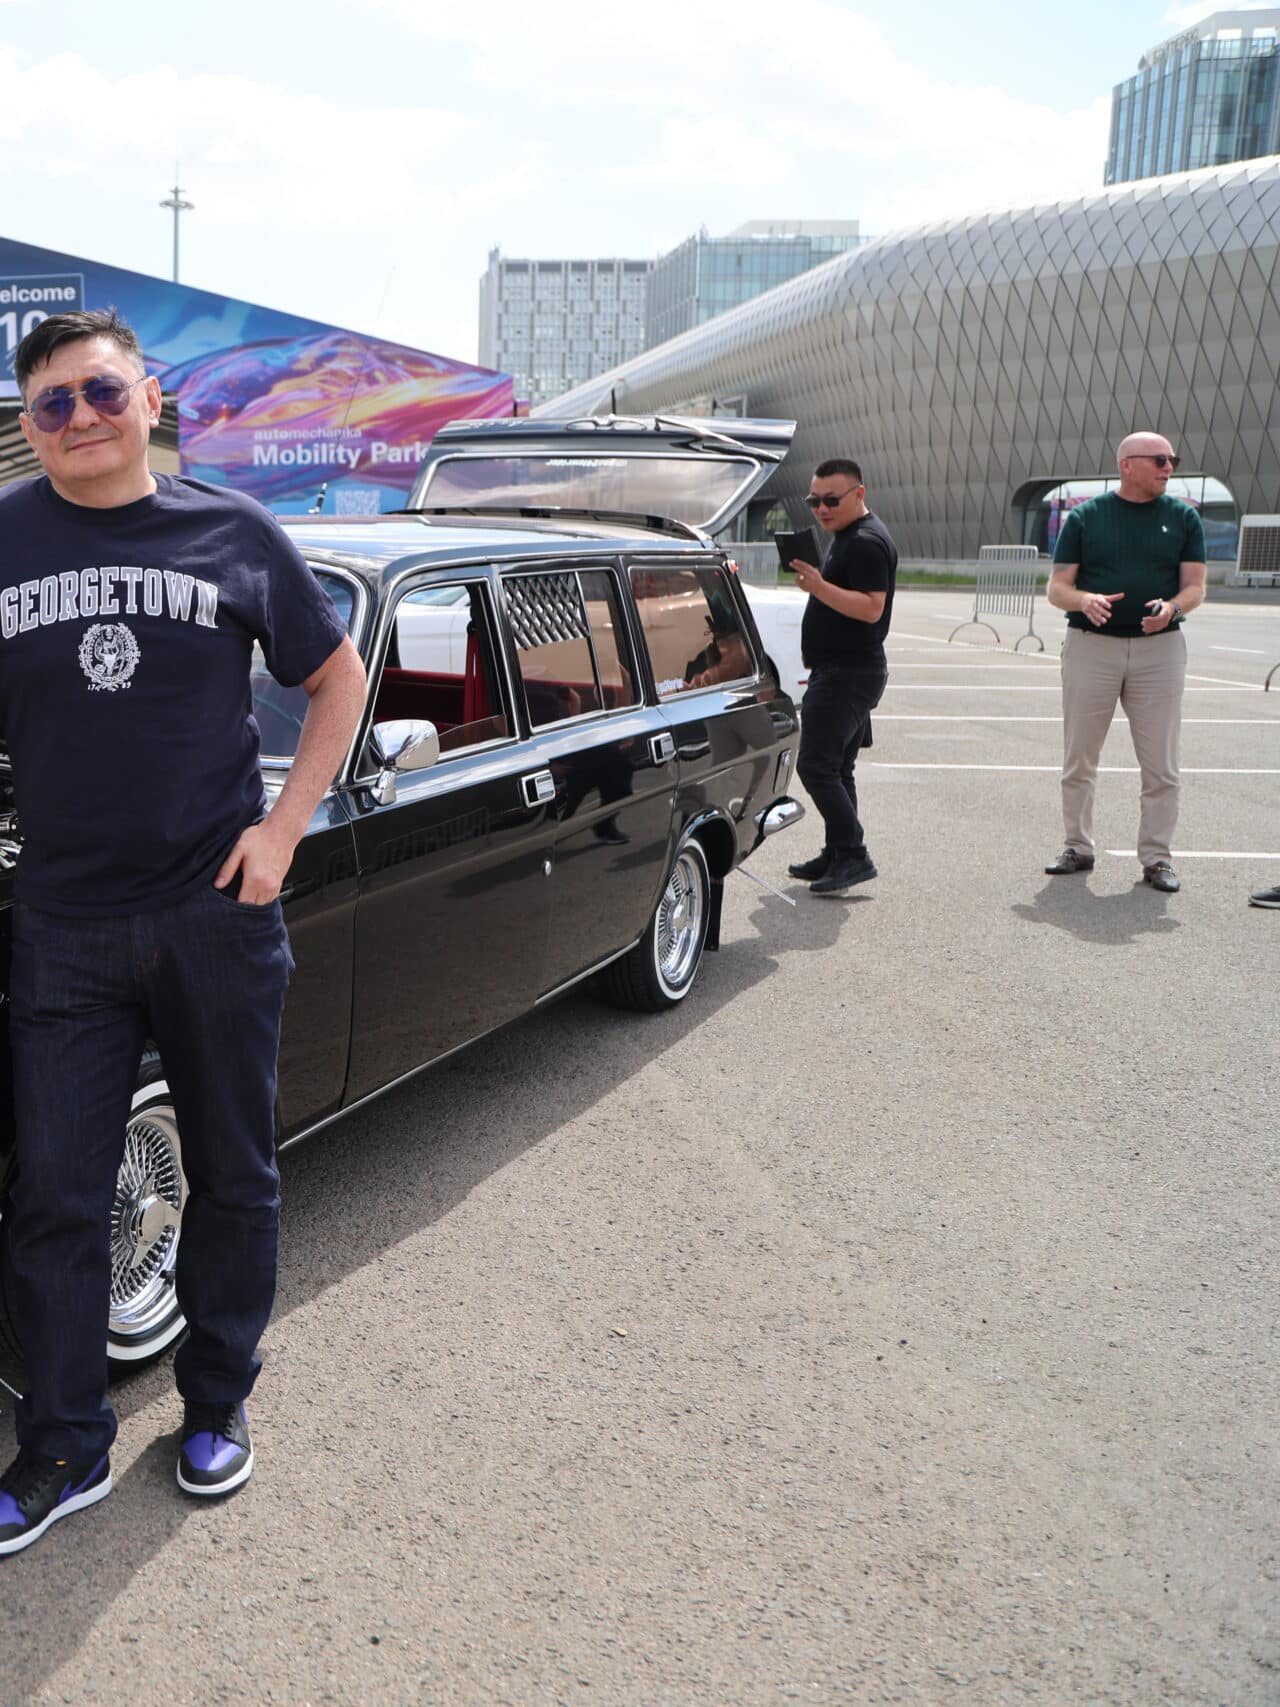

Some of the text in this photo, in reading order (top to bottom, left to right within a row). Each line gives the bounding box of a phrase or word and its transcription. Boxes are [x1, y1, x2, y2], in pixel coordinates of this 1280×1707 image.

[254, 428, 361, 441] automechanika
[253, 442, 428, 468] Mobility Park
[0, 566, 218, 639] GEORGETOWN
